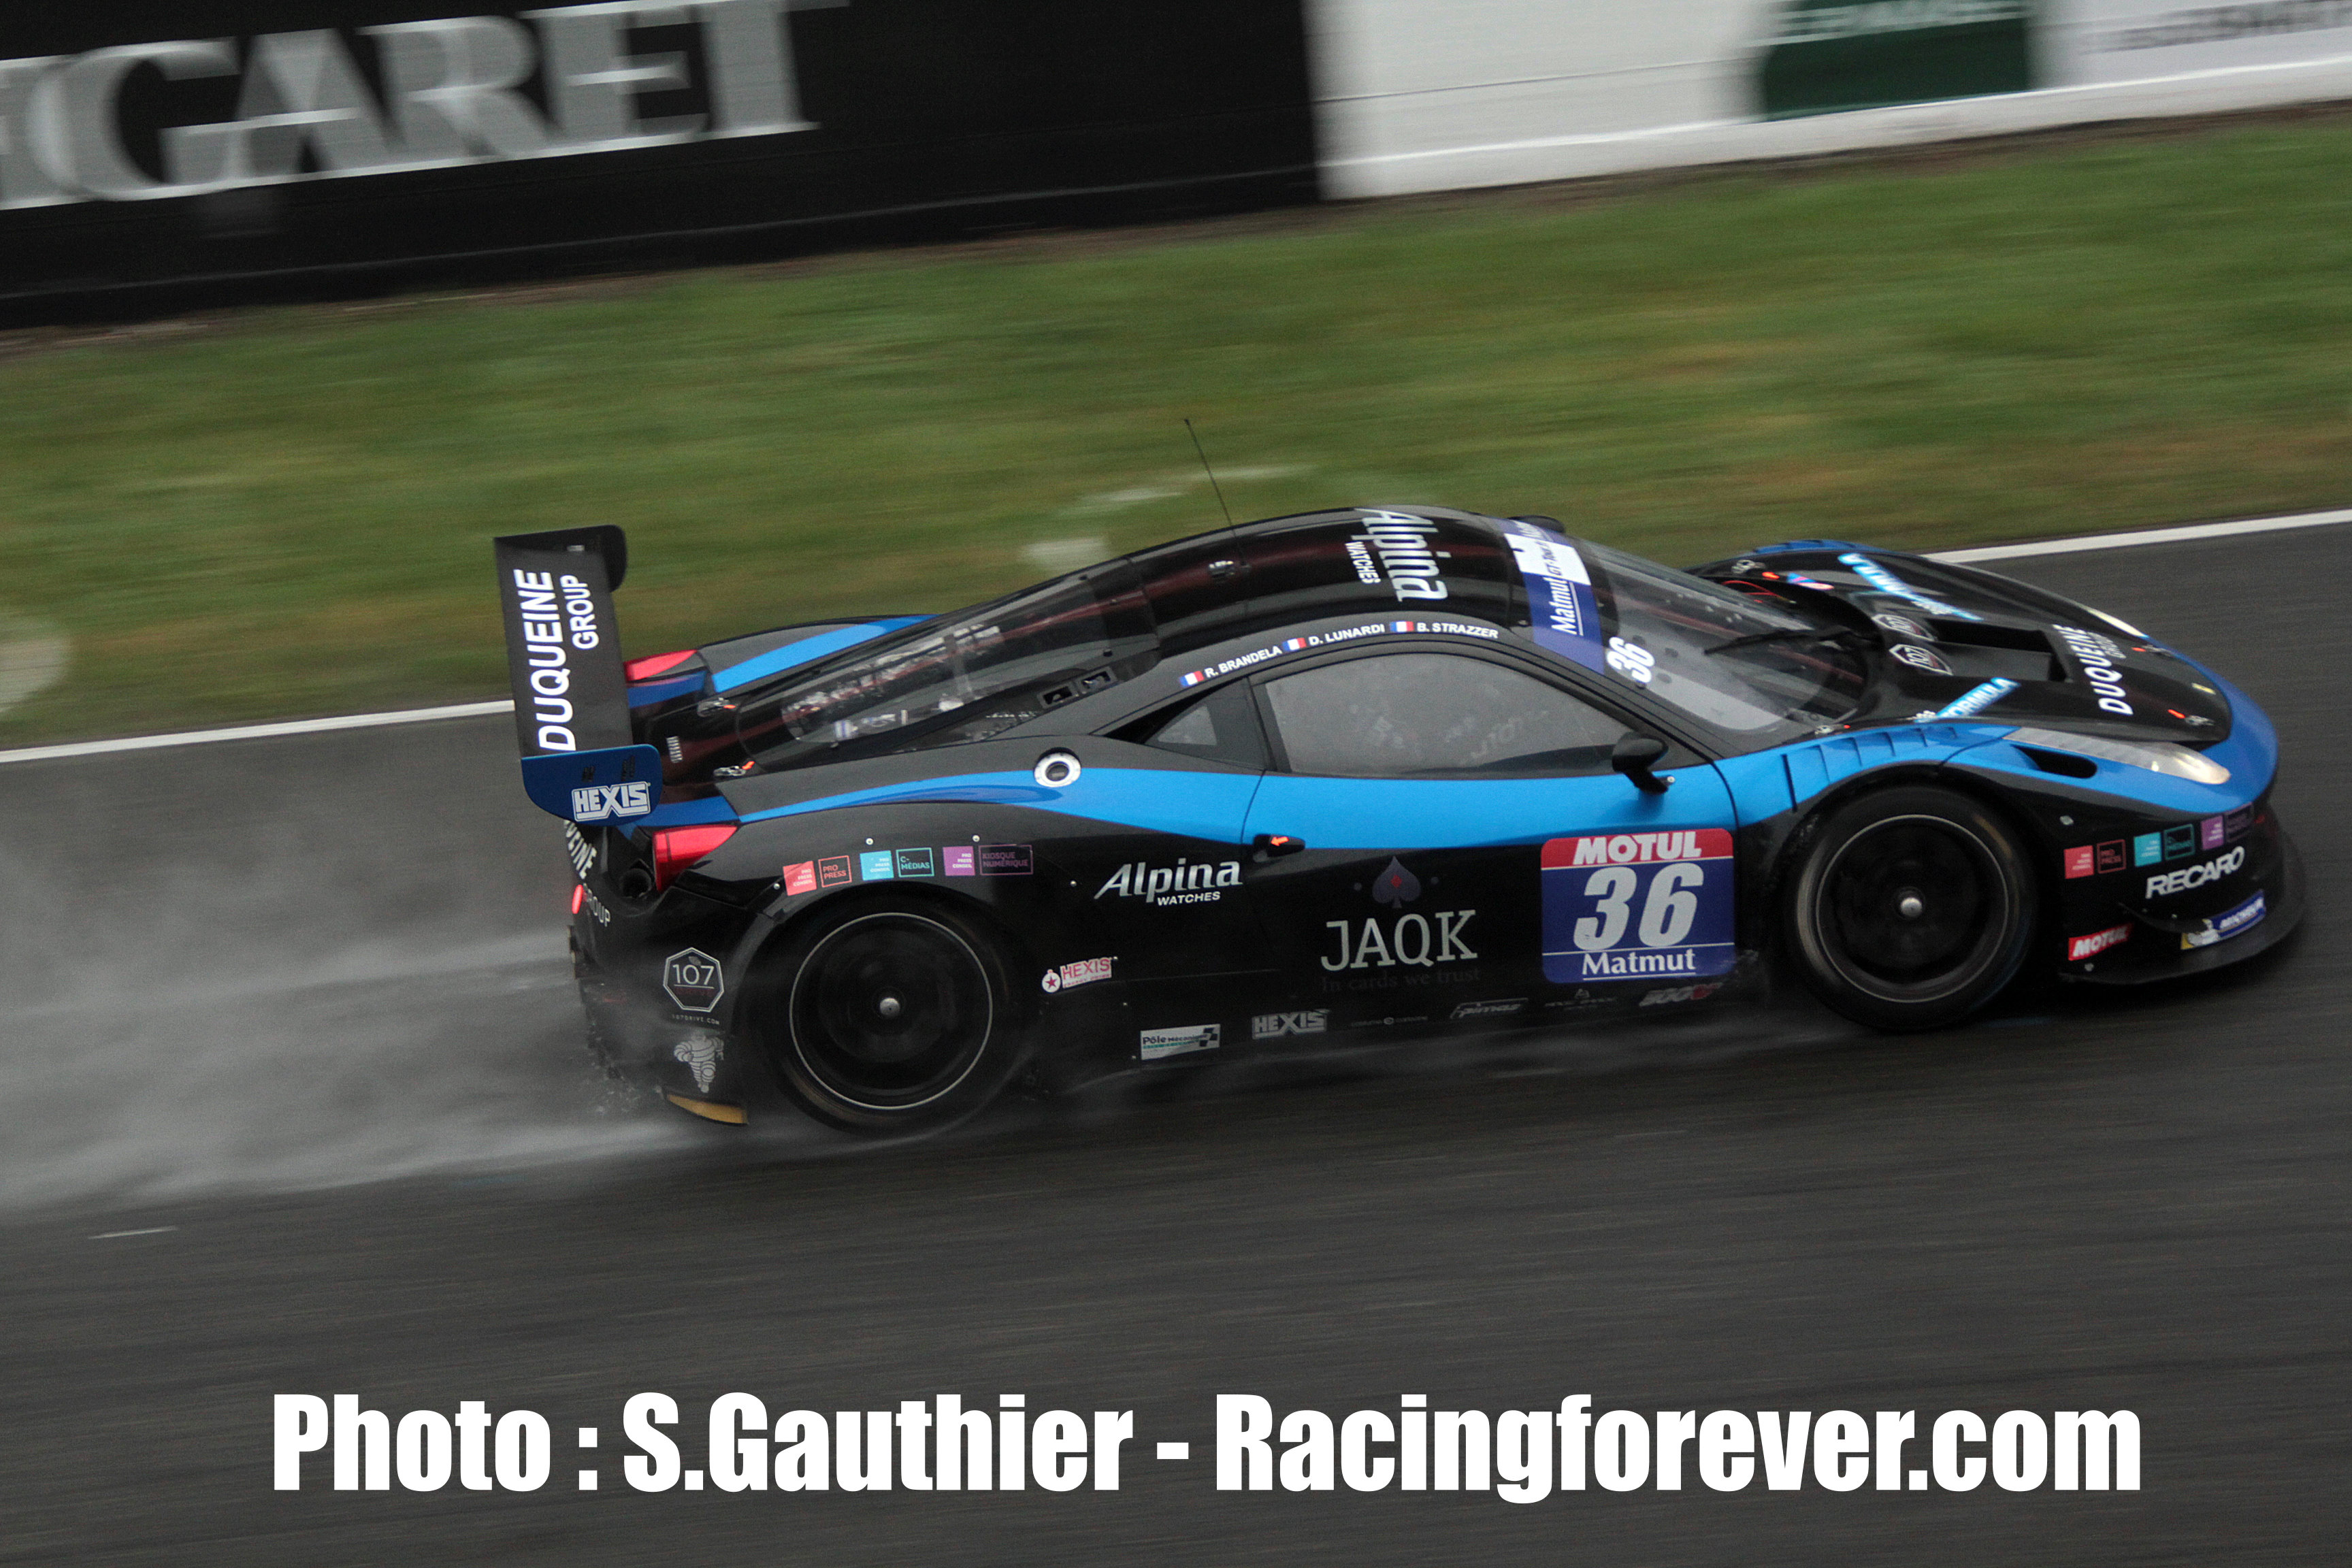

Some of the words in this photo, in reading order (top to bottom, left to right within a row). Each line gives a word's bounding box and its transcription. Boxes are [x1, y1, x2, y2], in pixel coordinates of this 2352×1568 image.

[1345, 541, 1382, 585] WATCHES
[1354, 508, 1452, 602] Alpina
[560, 574, 600, 651] GROUP
[1542, 576, 1578, 635] Matmut
[1308, 635, 1323, 647] D.
[1325, 623, 1385, 644] LUNARDI
[1417, 622, 1430, 632] B.
[1432, 622, 1499, 639] STRAZZER
[514, 569, 576, 751] DUQUEINE
[1204, 667, 1219, 679] R.
[1219, 645, 1282, 674] BRANDELA
[1606, 636, 1655, 683] 36
[2052, 623, 2134, 716] DUQUEINE
[573, 783, 649, 819] HEXIS
[900, 861, 931, 870] MÉDIAS
[982, 852, 1016, 861] KIOSQUE
[1573, 832, 1702, 866] MOTUL
[823, 864, 838, 872] PRO
[823, 870, 847, 880] PRESS
[1094, 858, 1243, 903] Alpina
[2145, 846, 2245, 900] RECARO
[1158, 891, 1221, 906] WATCHES
[1573, 862, 1705, 951] 36
[1321, 909, 1479, 972] JAQK
[2072, 924, 2128, 958] MOTUL
[672, 963, 715, 986] 107
[1062, 958, 1111, 980] HEXIS
[1582, 948, 1697, 976] Matmut
[1321, 975, 1341, 993] In
[1348, 970, 1399, 990] cards
[1404, 973, 1430, 985] we
[1436, 966, 1482, 984] trust
[1142, 1035, 1167, 1045] Pôle
[1254, 1011, 1326, 1038] HEXIS
